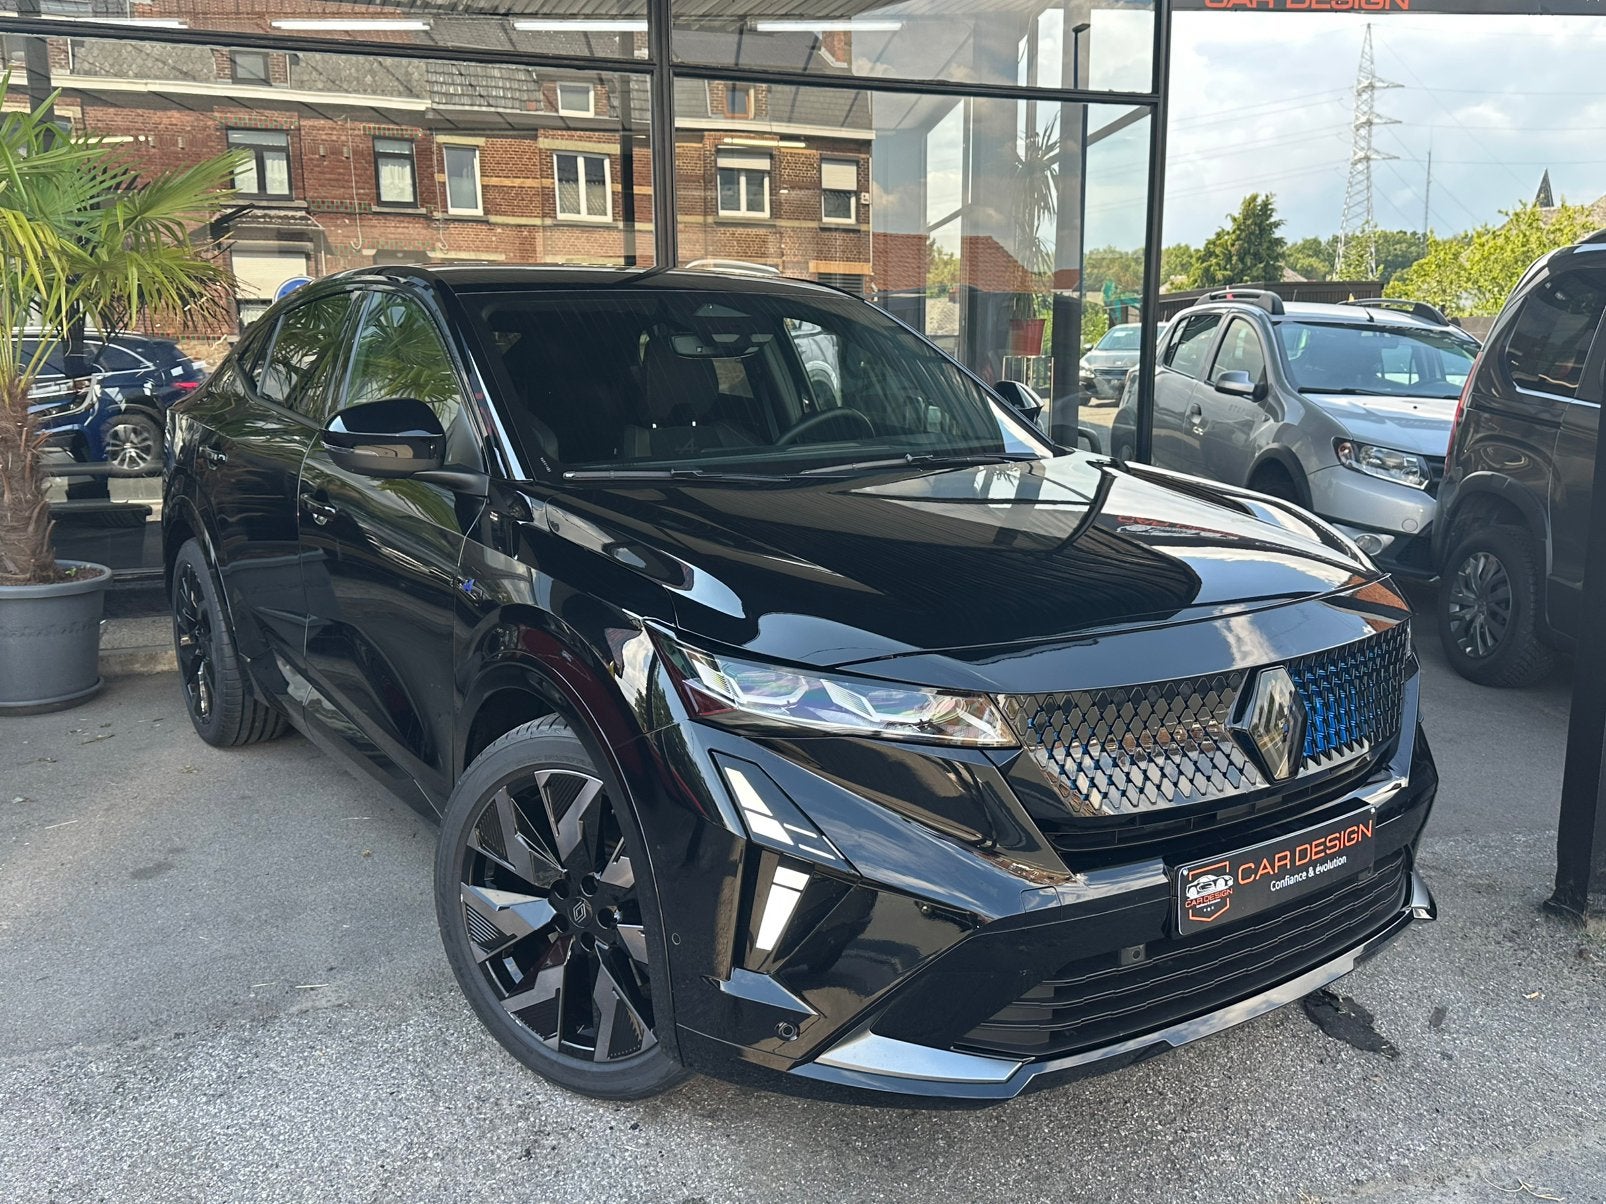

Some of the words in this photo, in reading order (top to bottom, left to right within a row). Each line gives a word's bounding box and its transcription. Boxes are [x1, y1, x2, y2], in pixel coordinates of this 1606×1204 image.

[1238, 850, 1291, 885] CAR
[1295, 819, 1373, 867] DESIGN
[1270, 871, 1307, 892] Confiance
[1307, 866, 1315, 878] &
[1315, 855, 1347, 875] évolution
[1185, 897, 1203, 908] CAR
[1203, 888, 1233, 902] DESIGN
